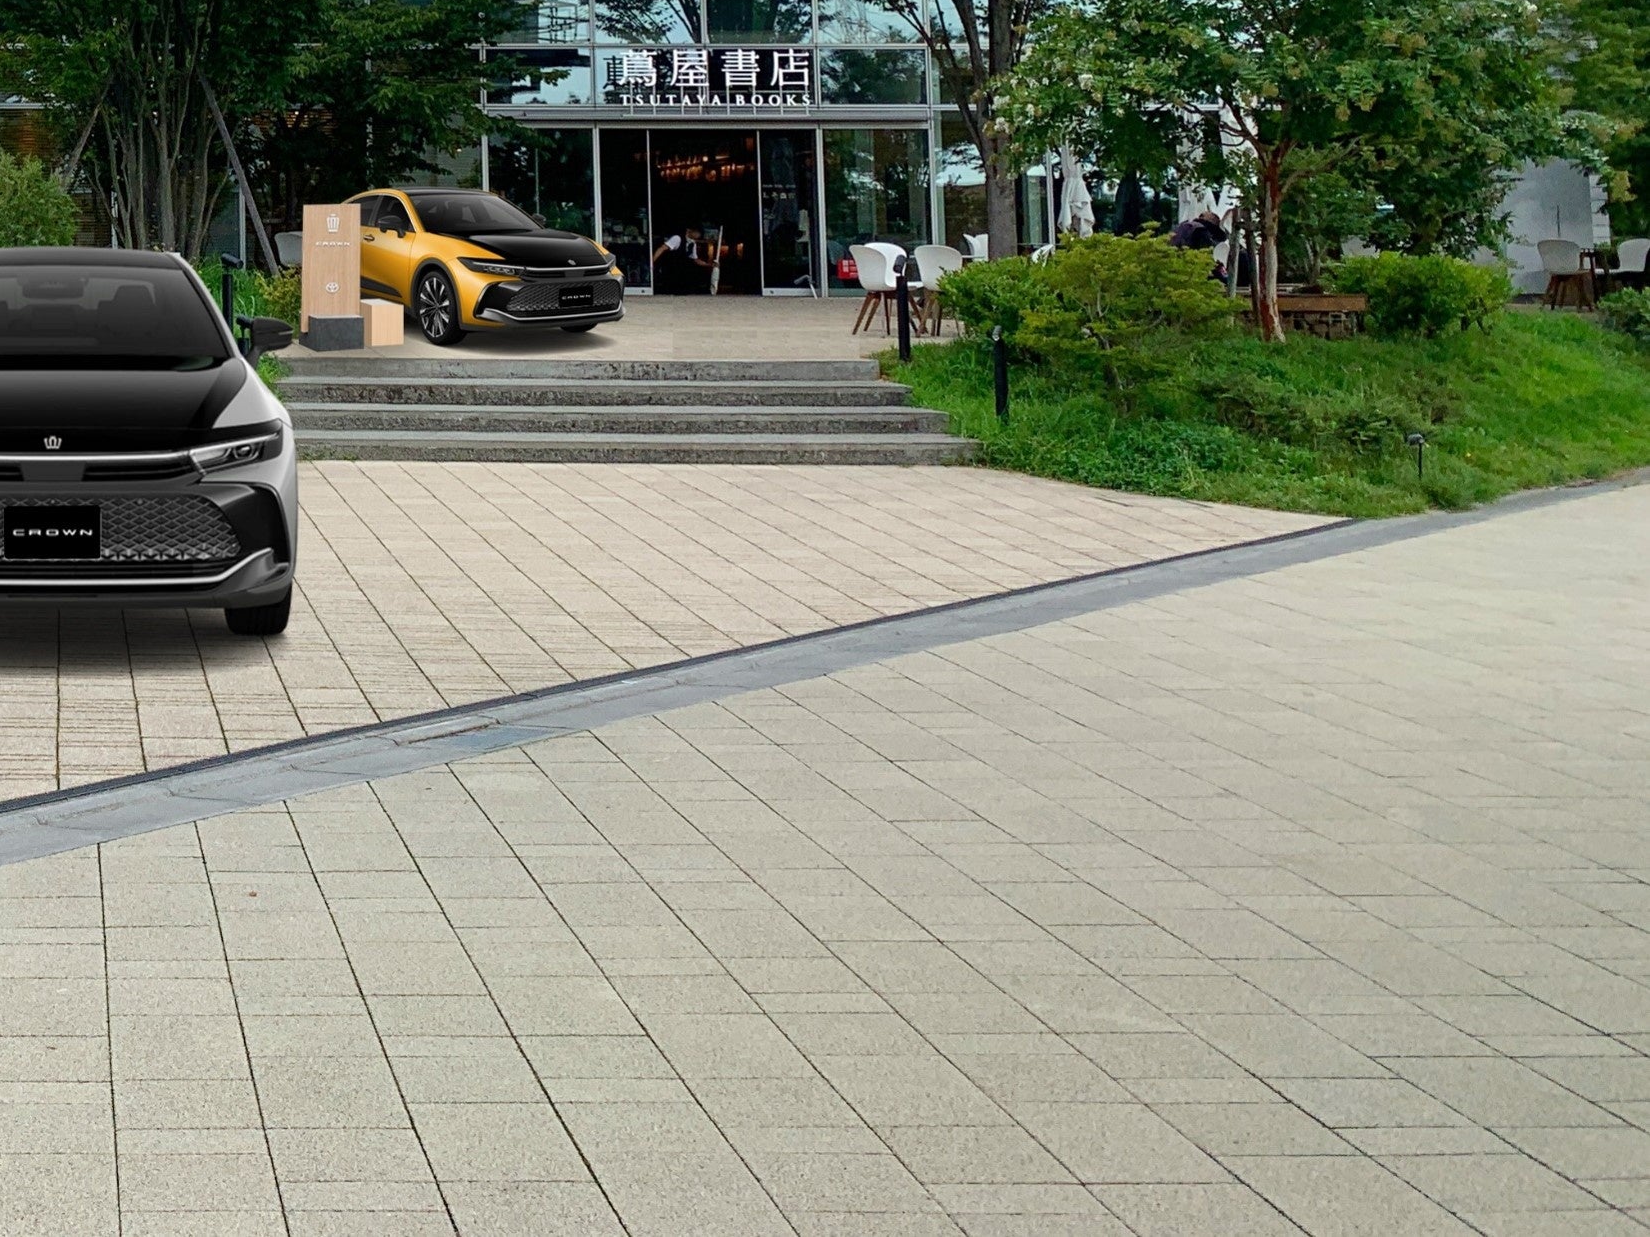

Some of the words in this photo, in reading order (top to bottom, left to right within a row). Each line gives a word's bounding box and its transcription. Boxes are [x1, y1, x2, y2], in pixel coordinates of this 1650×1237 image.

[619, 48, 811, 87] 蔦屋書店
[619, 94, 721, 106] TSUTAYA
[736, 94, 811, 106] BOOKS
[12, 528, 93, 536] CROWN
